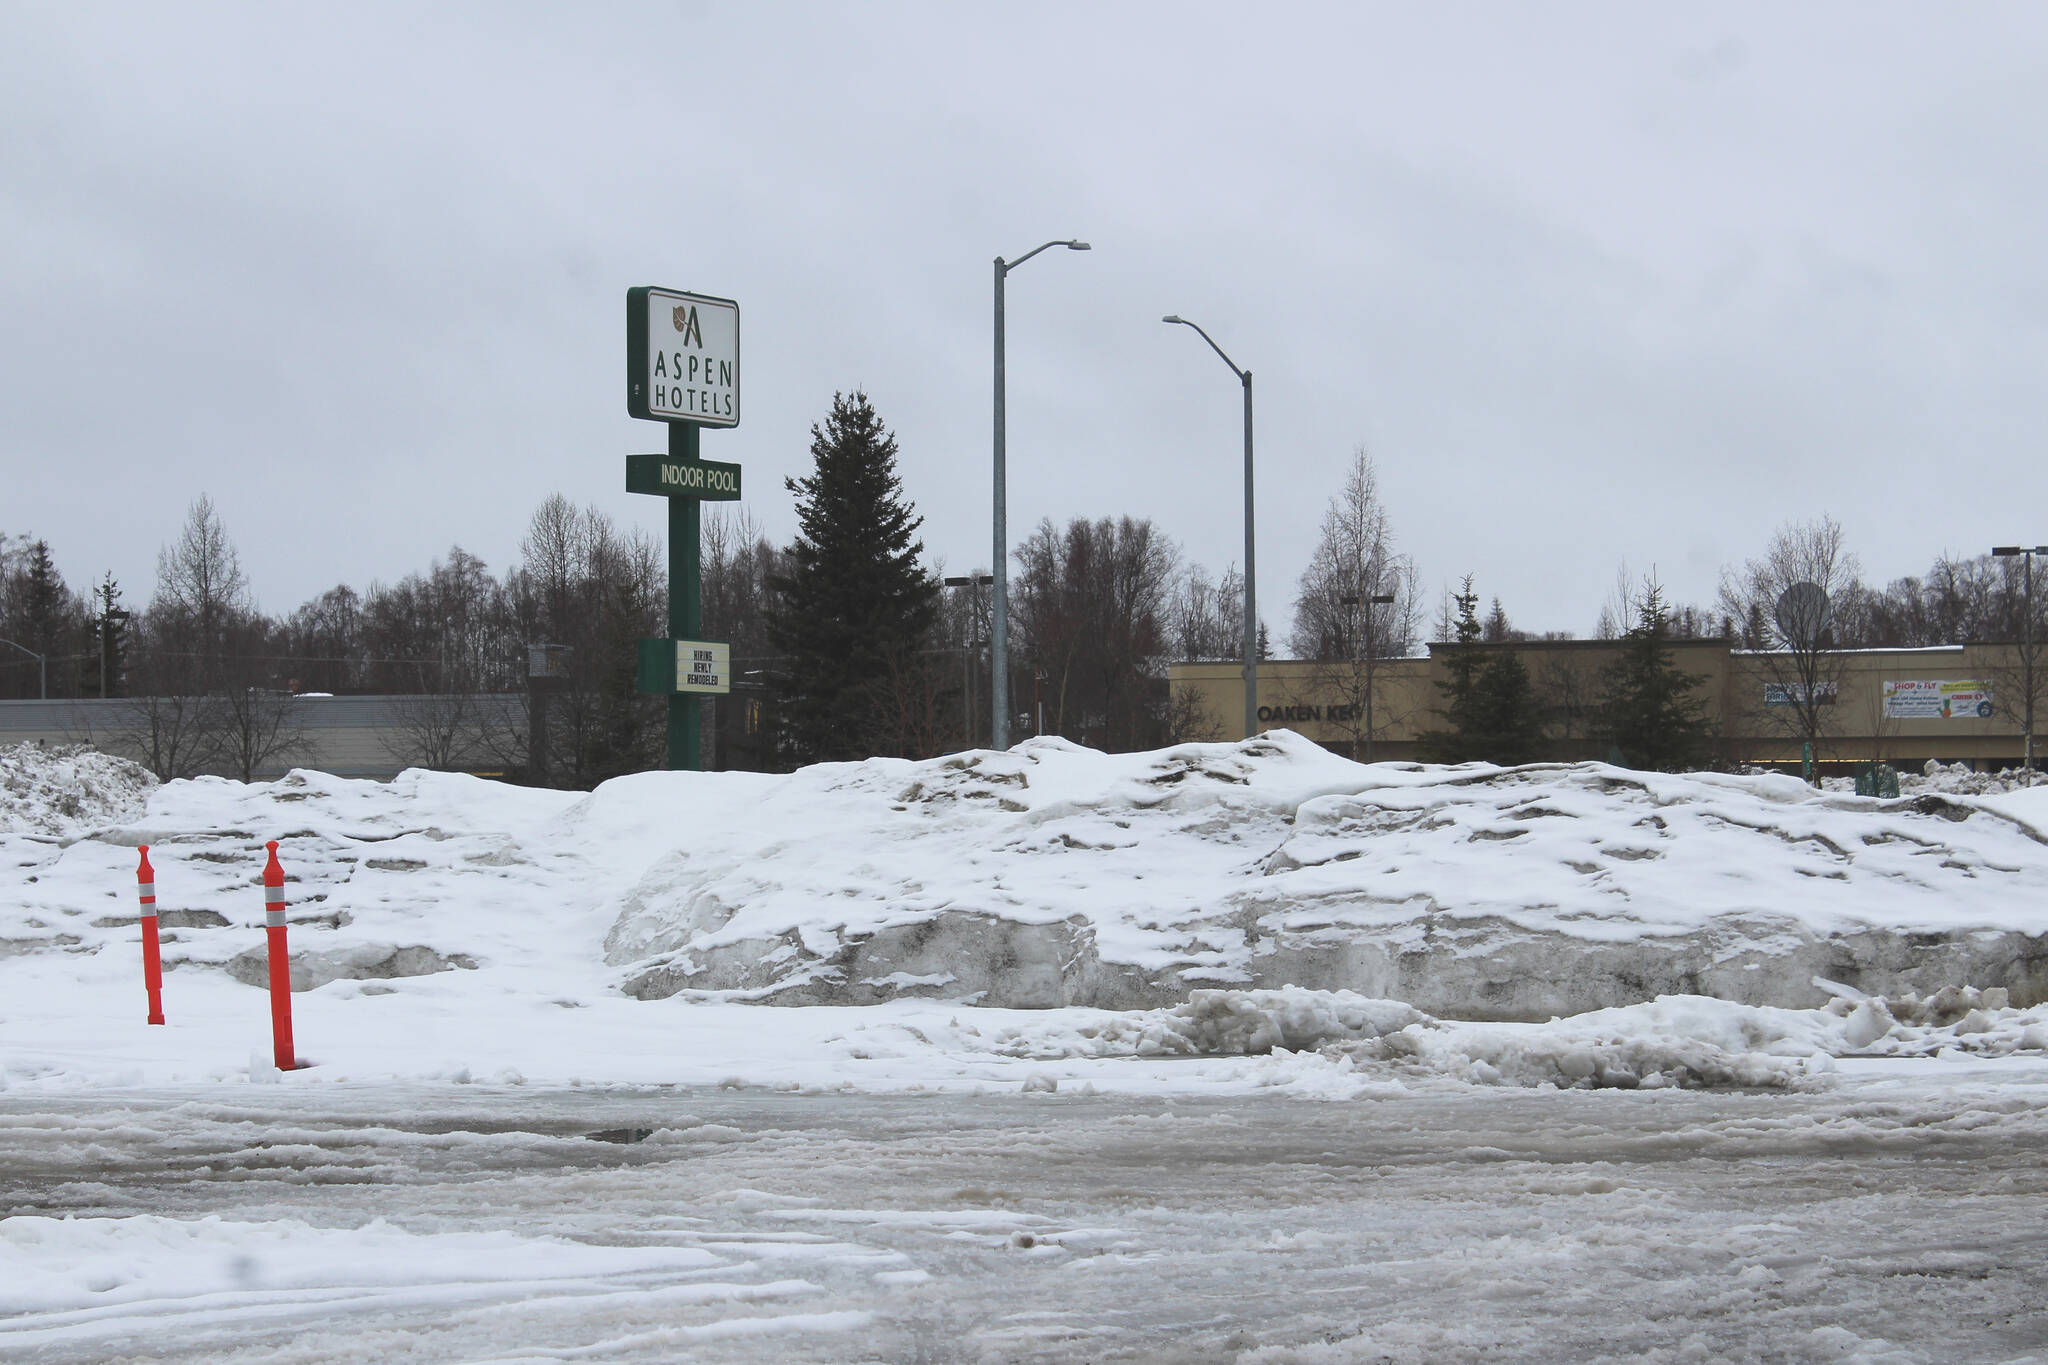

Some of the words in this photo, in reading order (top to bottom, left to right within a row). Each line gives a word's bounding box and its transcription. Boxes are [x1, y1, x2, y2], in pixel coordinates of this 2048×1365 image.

[654, 350, 732, 388] ASPEN
[655, 384, 732, 416] HOTELS
[661, 463, 704, 488] INDOOR
[707, 470, 738, 492] POOL
[693, 650, 713, 662] HIRING
[693, 662, 713, 673] NEWLY
[687, 673, 719, 686] REMODELED
[1894, 682, 1916, 690] SHOP
[1257, 705, 1321, 722] OAKEN
